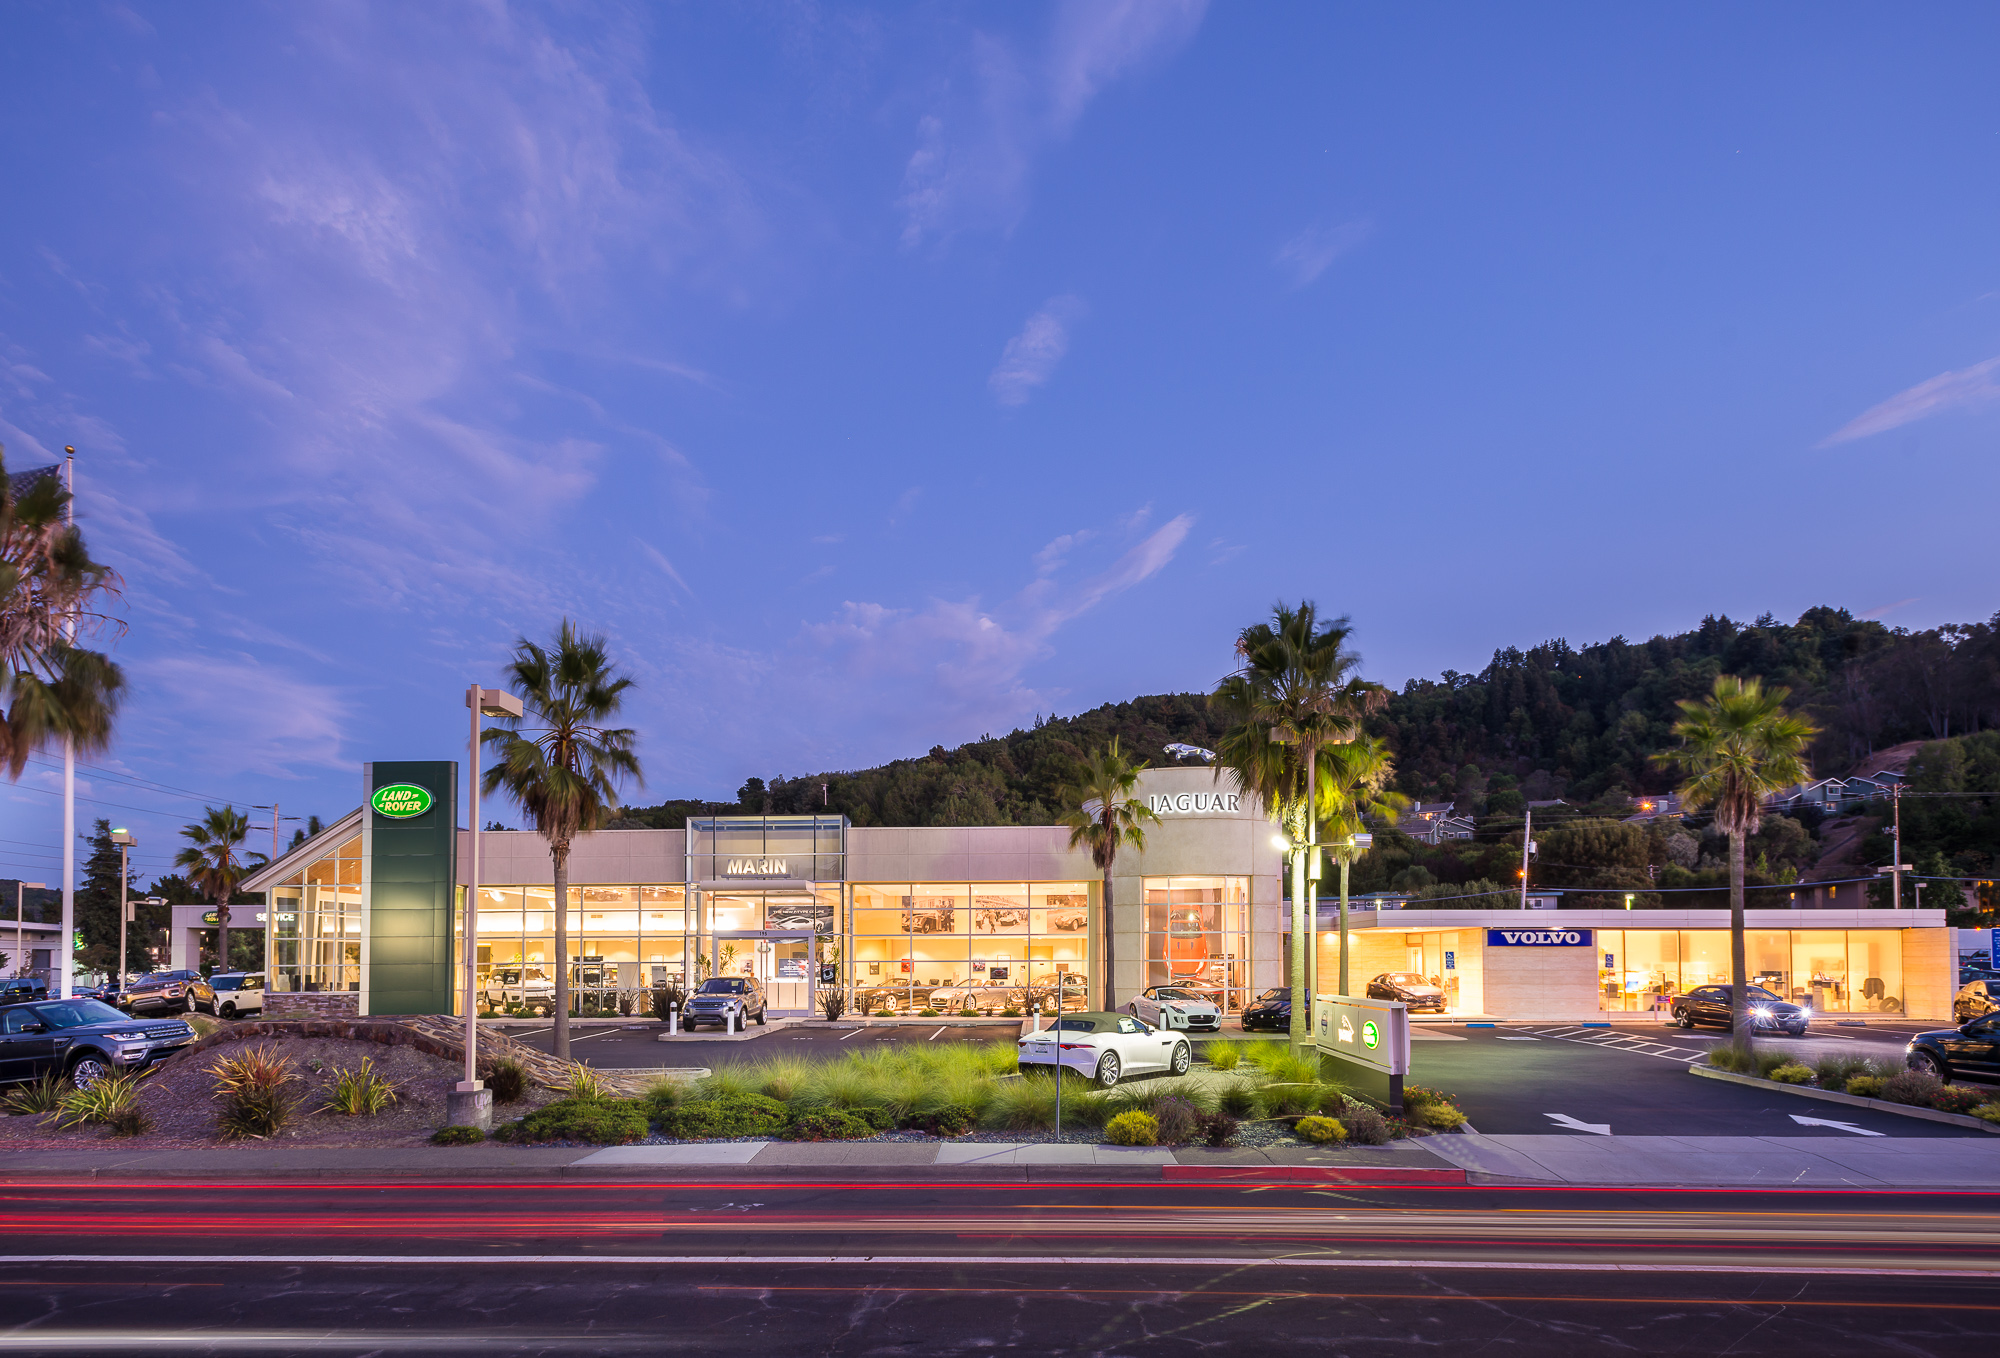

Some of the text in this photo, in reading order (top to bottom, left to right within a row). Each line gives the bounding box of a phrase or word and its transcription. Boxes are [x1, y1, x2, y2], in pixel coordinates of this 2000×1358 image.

[381, 791, 412, 801] LAND
[384, 801, 421, 811] ROVER
[1148, 794, 1239, 816] JAGUAR
[727, 859, 787, 875] MARIN
[255, 912, 295, 922] SEVICE
[1501, 931, 1580, 944] VOLVO
